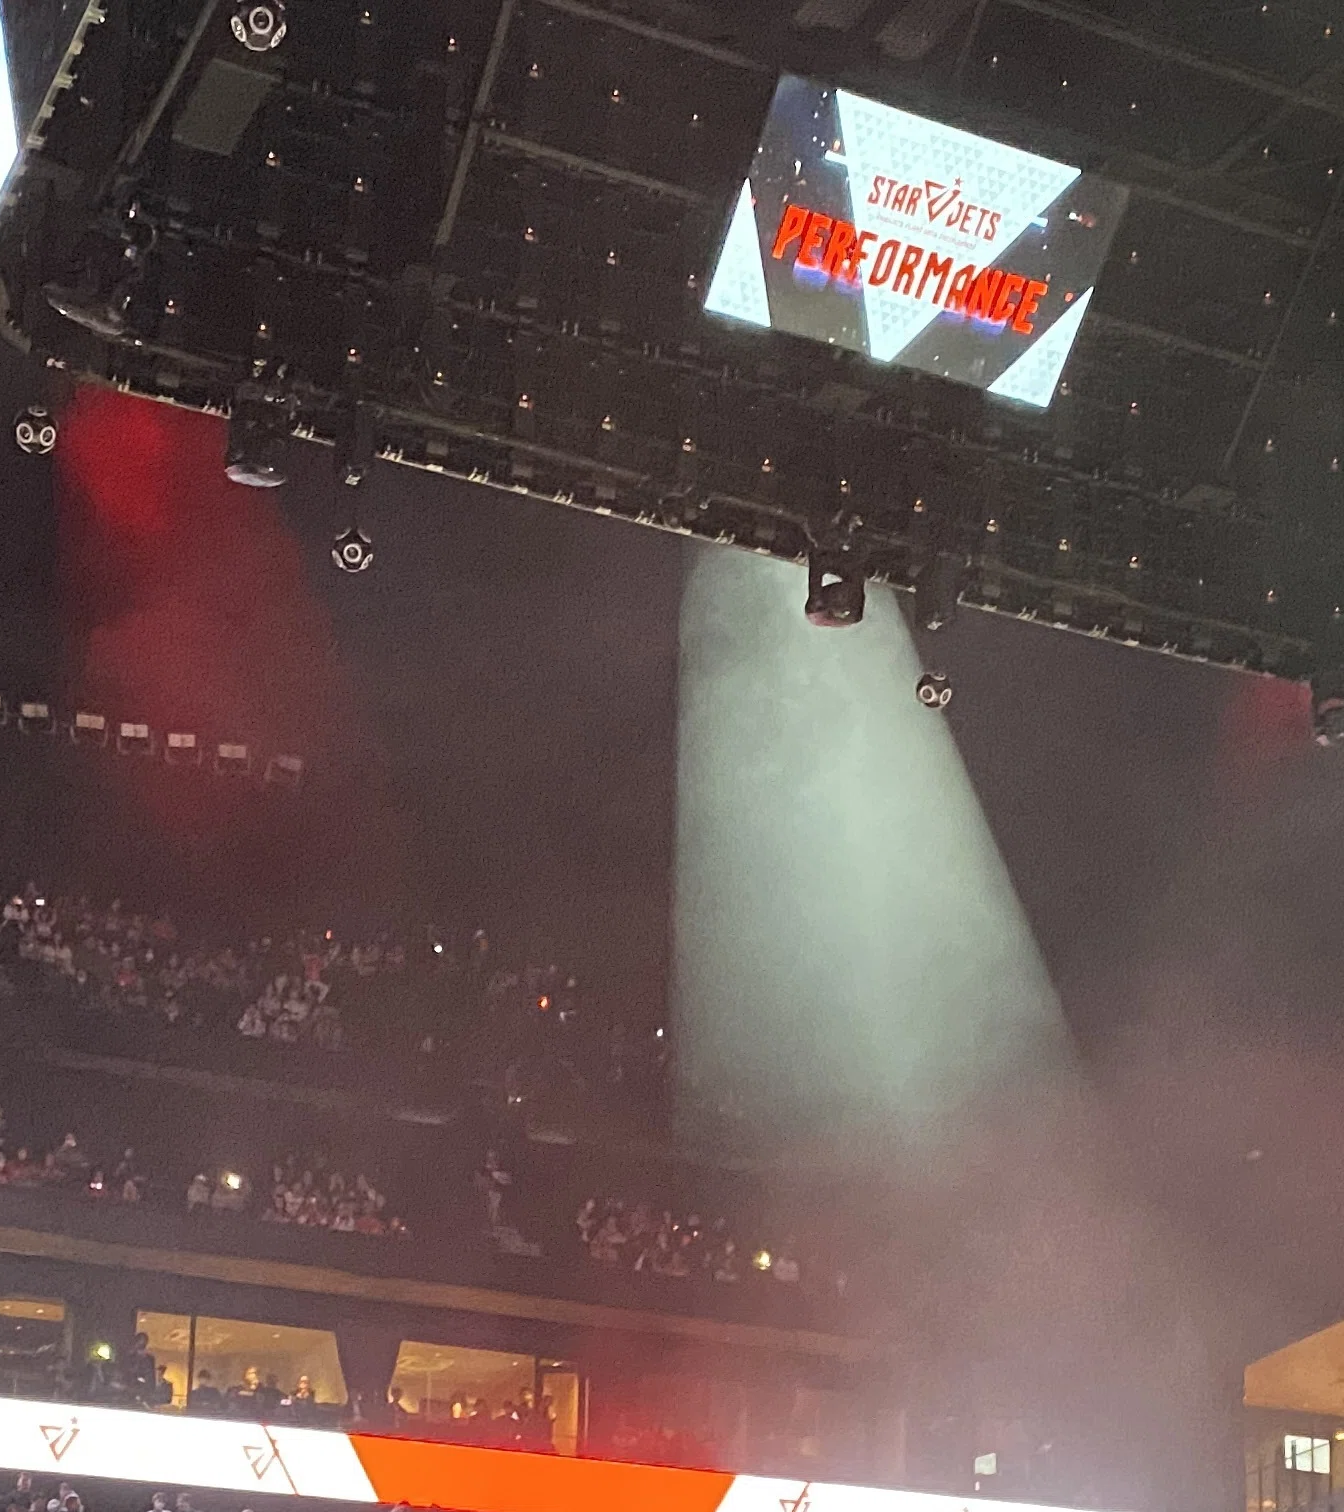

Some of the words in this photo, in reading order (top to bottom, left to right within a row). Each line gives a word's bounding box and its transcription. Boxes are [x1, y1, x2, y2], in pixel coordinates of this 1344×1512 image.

[867, 174, 923, 217] STAR
[945, 200, 1002, 242] JETS
[771, 203, 1050, 336] PERFORMANCE
